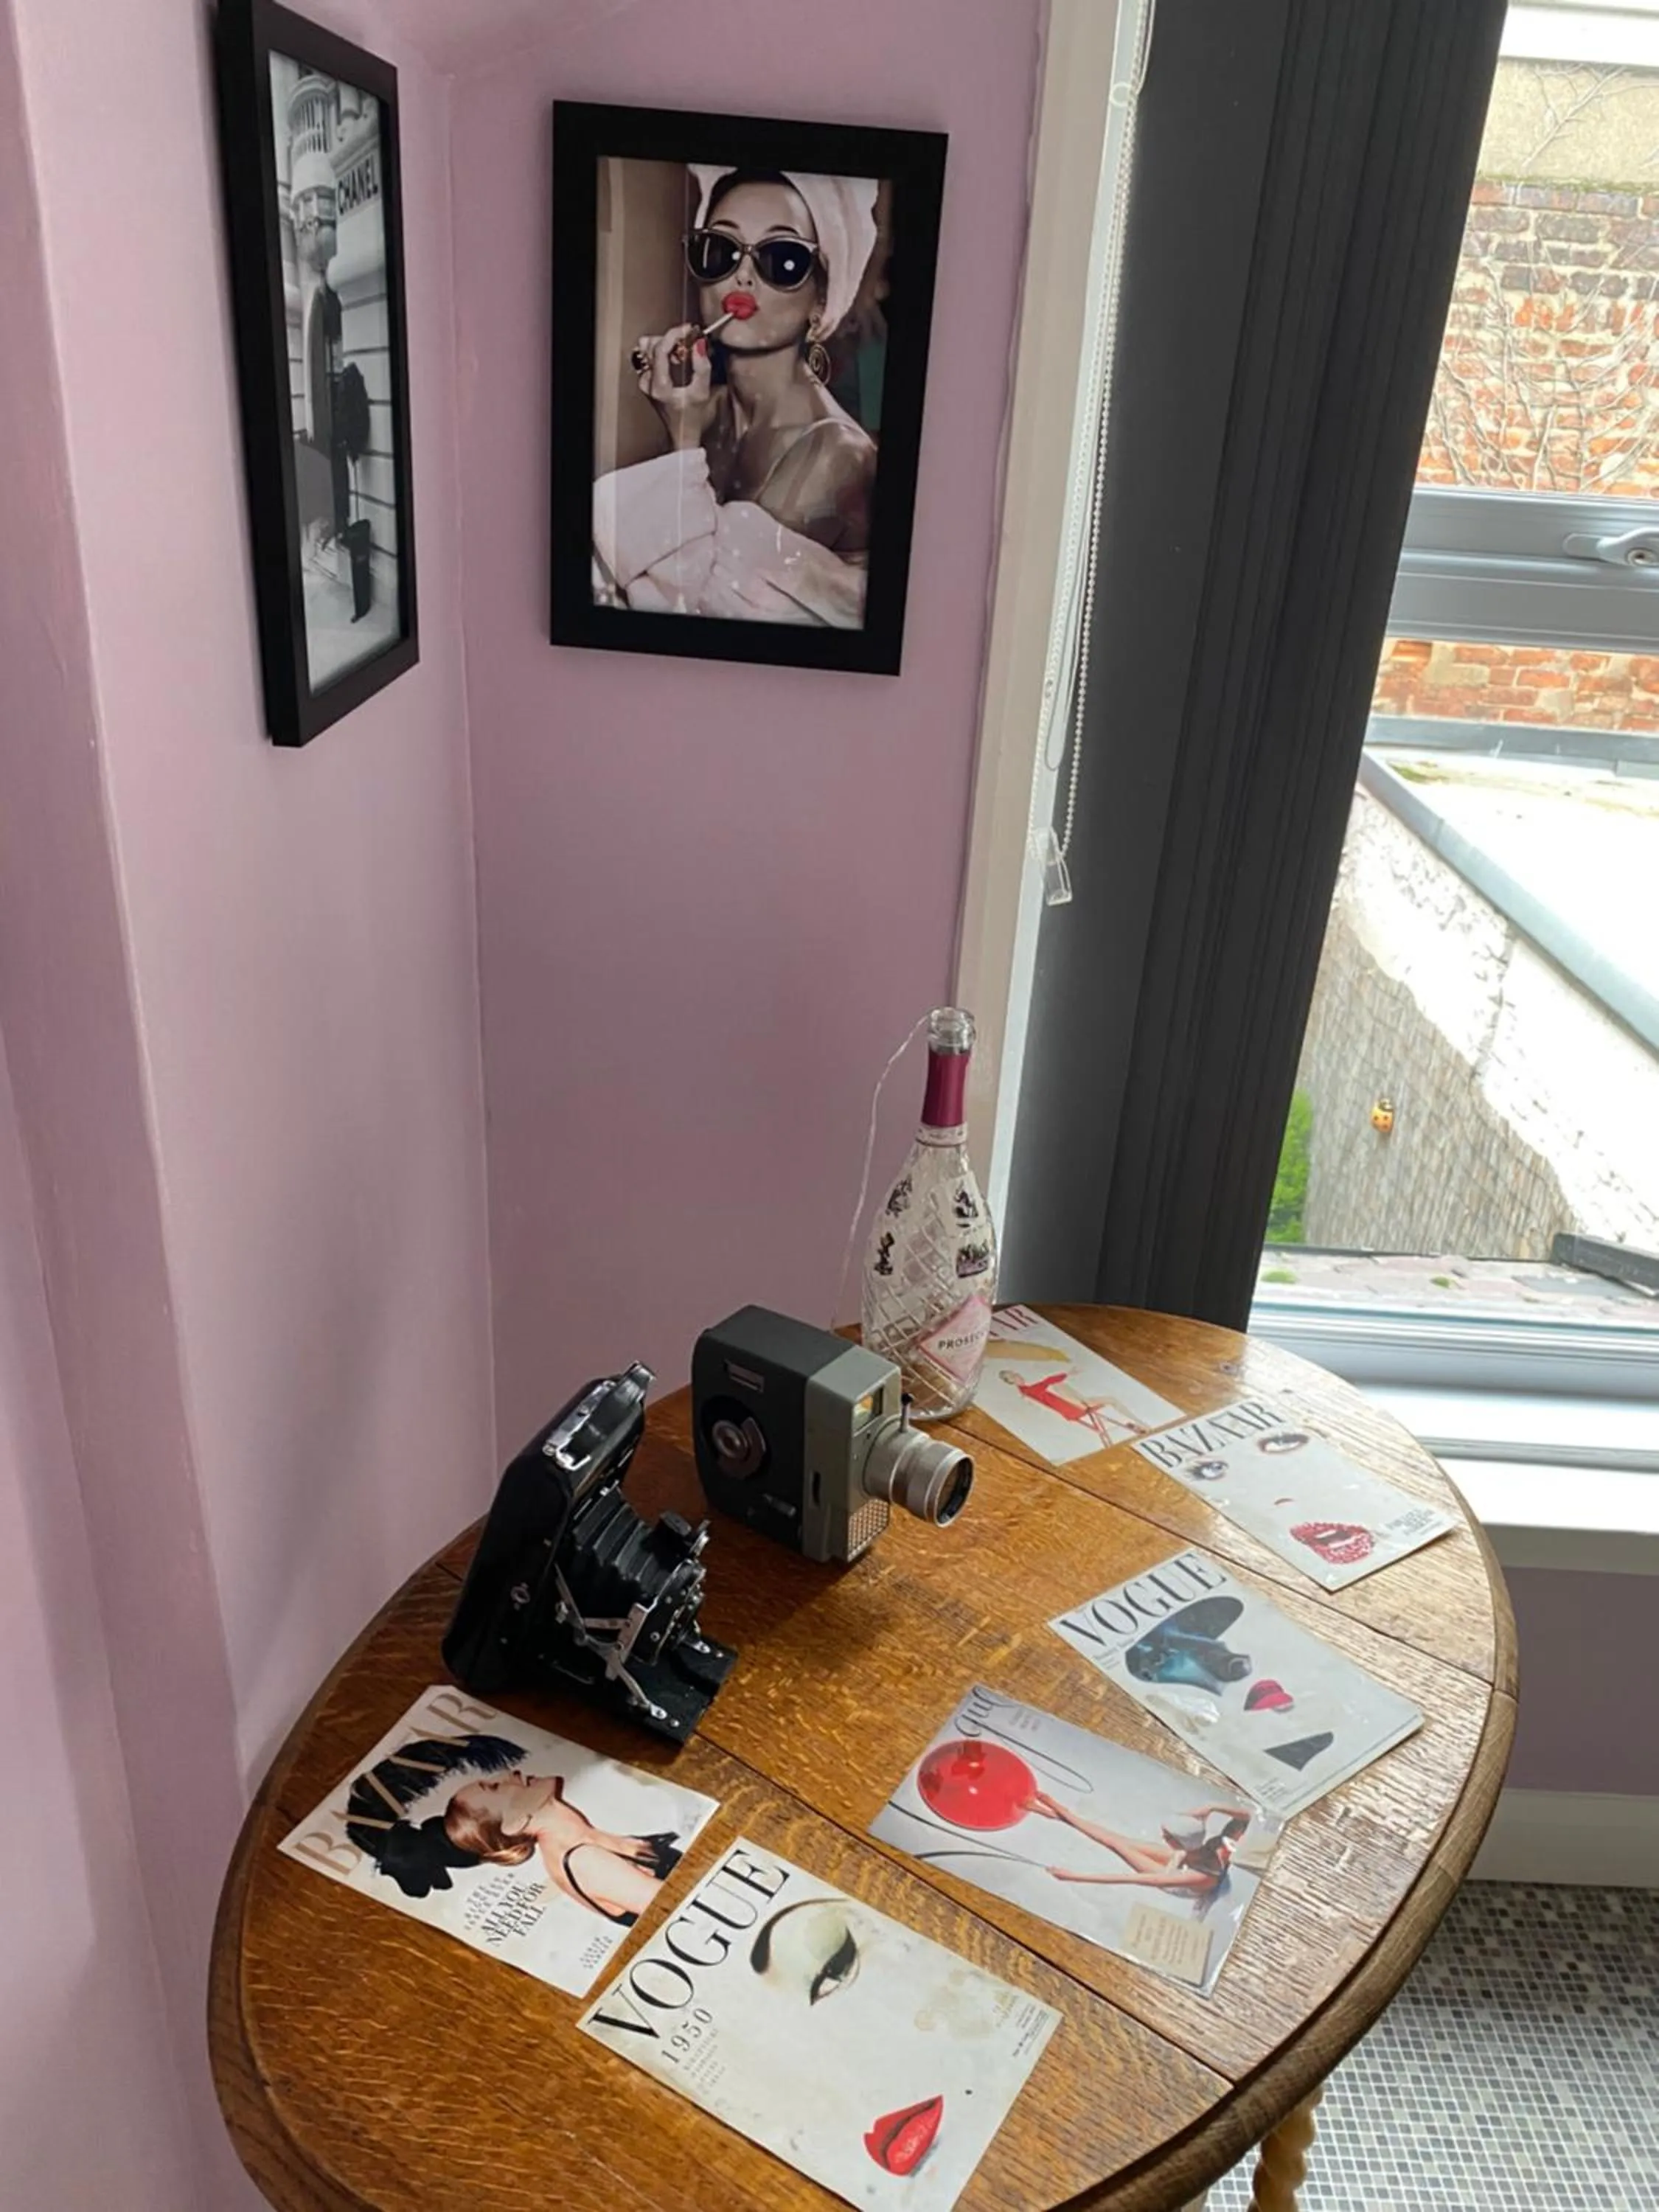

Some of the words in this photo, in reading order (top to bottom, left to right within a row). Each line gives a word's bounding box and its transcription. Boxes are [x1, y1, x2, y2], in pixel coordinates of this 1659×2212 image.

[338, 153, 378, 215] CHANEL
[1140, 1401, 1285, 1468] BAZAAR
[1057, 1553, 1227, 1646] VOGUE
[293, 1693, 498, 1876] BAZAAR
[481, 1910, 504, 1935] ALL
[486, 1908, 524, 1947] NEED
[516, 1882, 546, 1910] FOR
[512, 1905, 546, 1936] FALL
[587, 1848, 790, 2039] VOGUE
[661, 2008, 713, 2064] 1950
